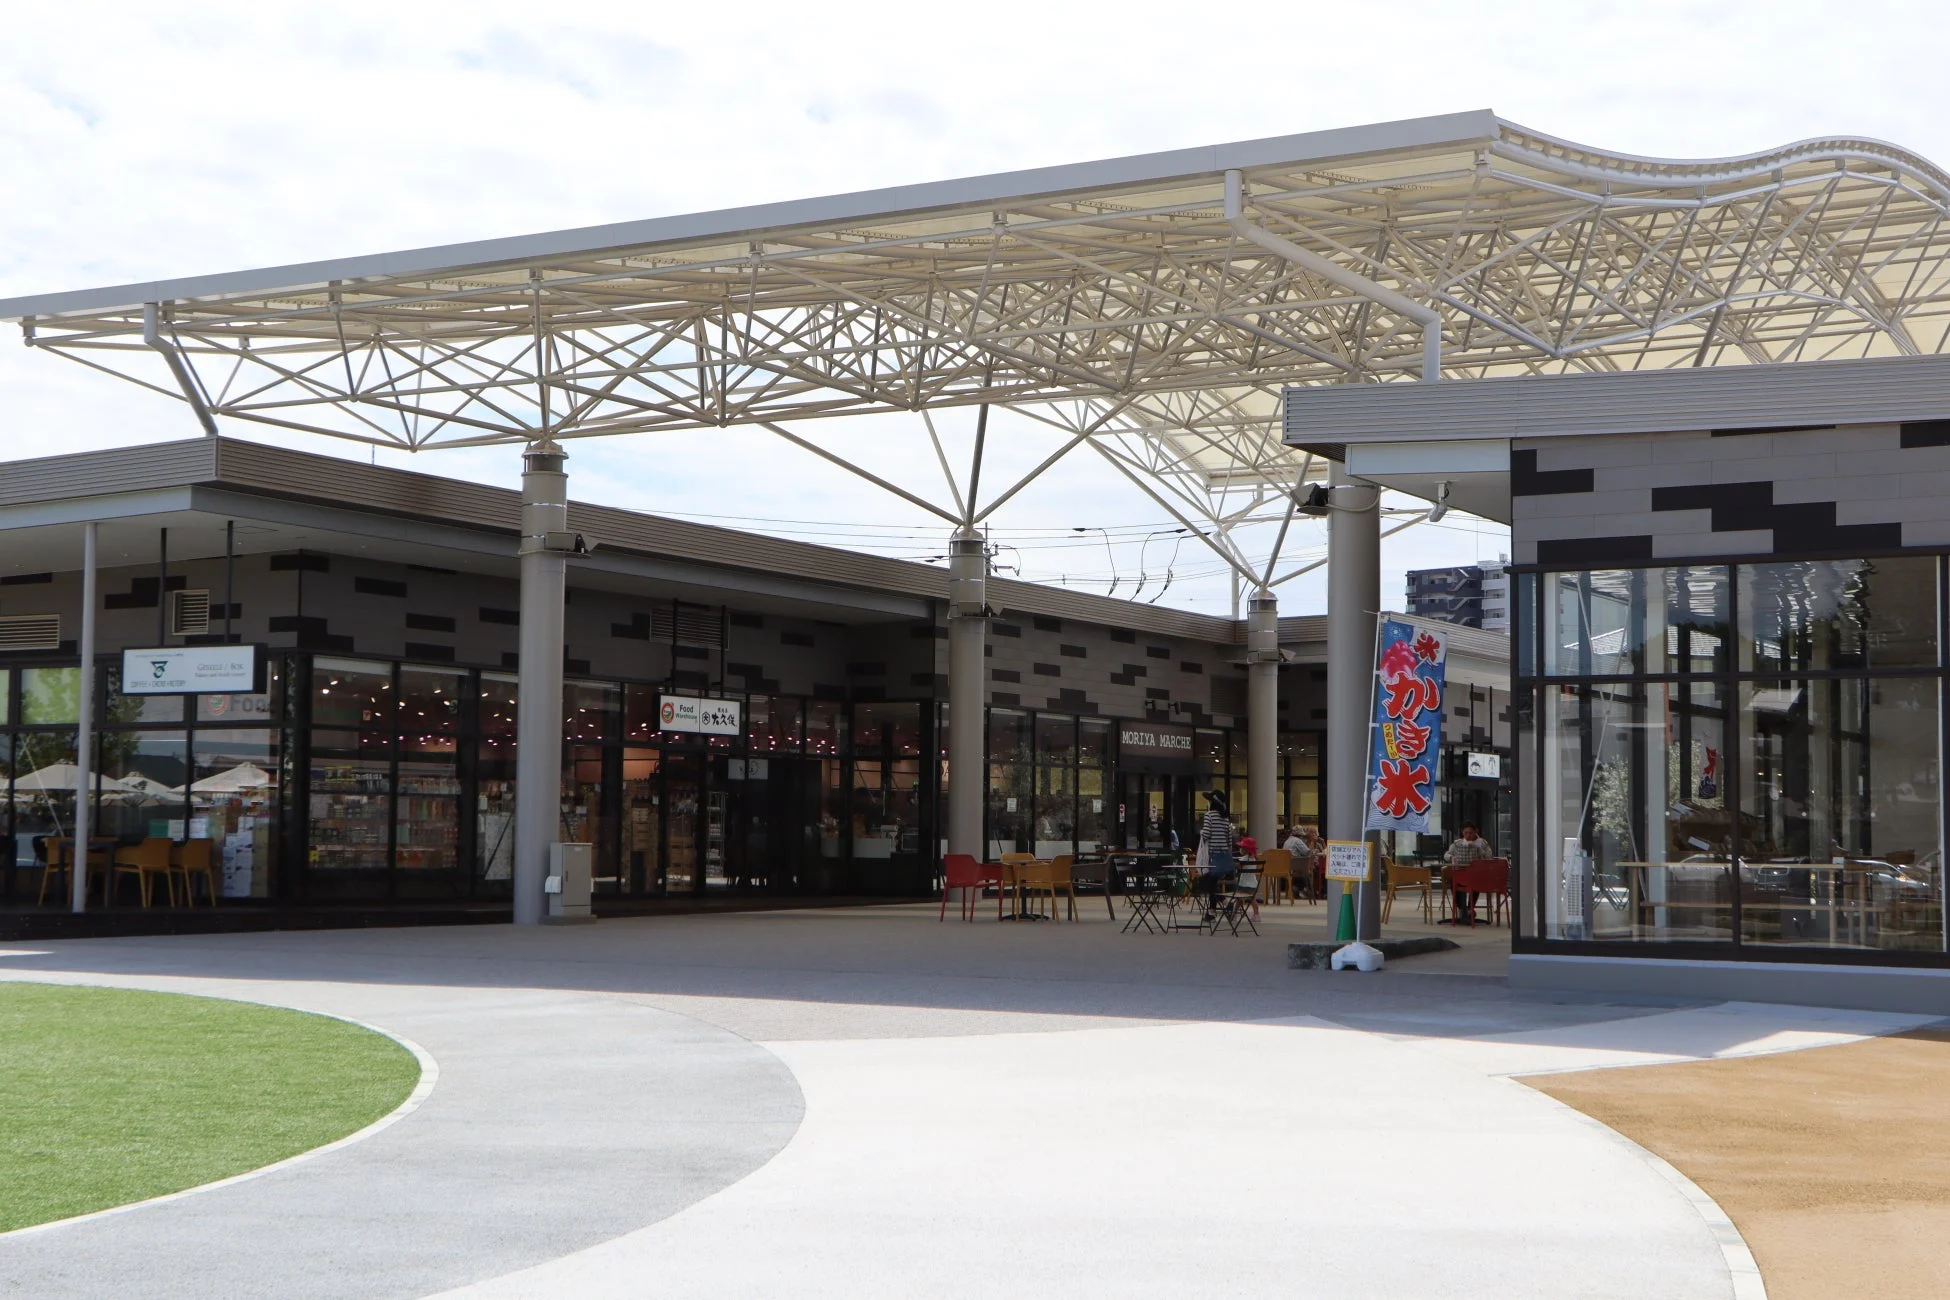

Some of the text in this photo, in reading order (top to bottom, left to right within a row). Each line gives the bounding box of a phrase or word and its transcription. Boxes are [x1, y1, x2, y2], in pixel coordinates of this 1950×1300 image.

[679, 704, 694, 713] Food
[675, 712, 698, 720] Warehouse
[1122, 730, 1192, 750] MORIYA MARCHE
[1376, 671, 1440, 818] かき氷
